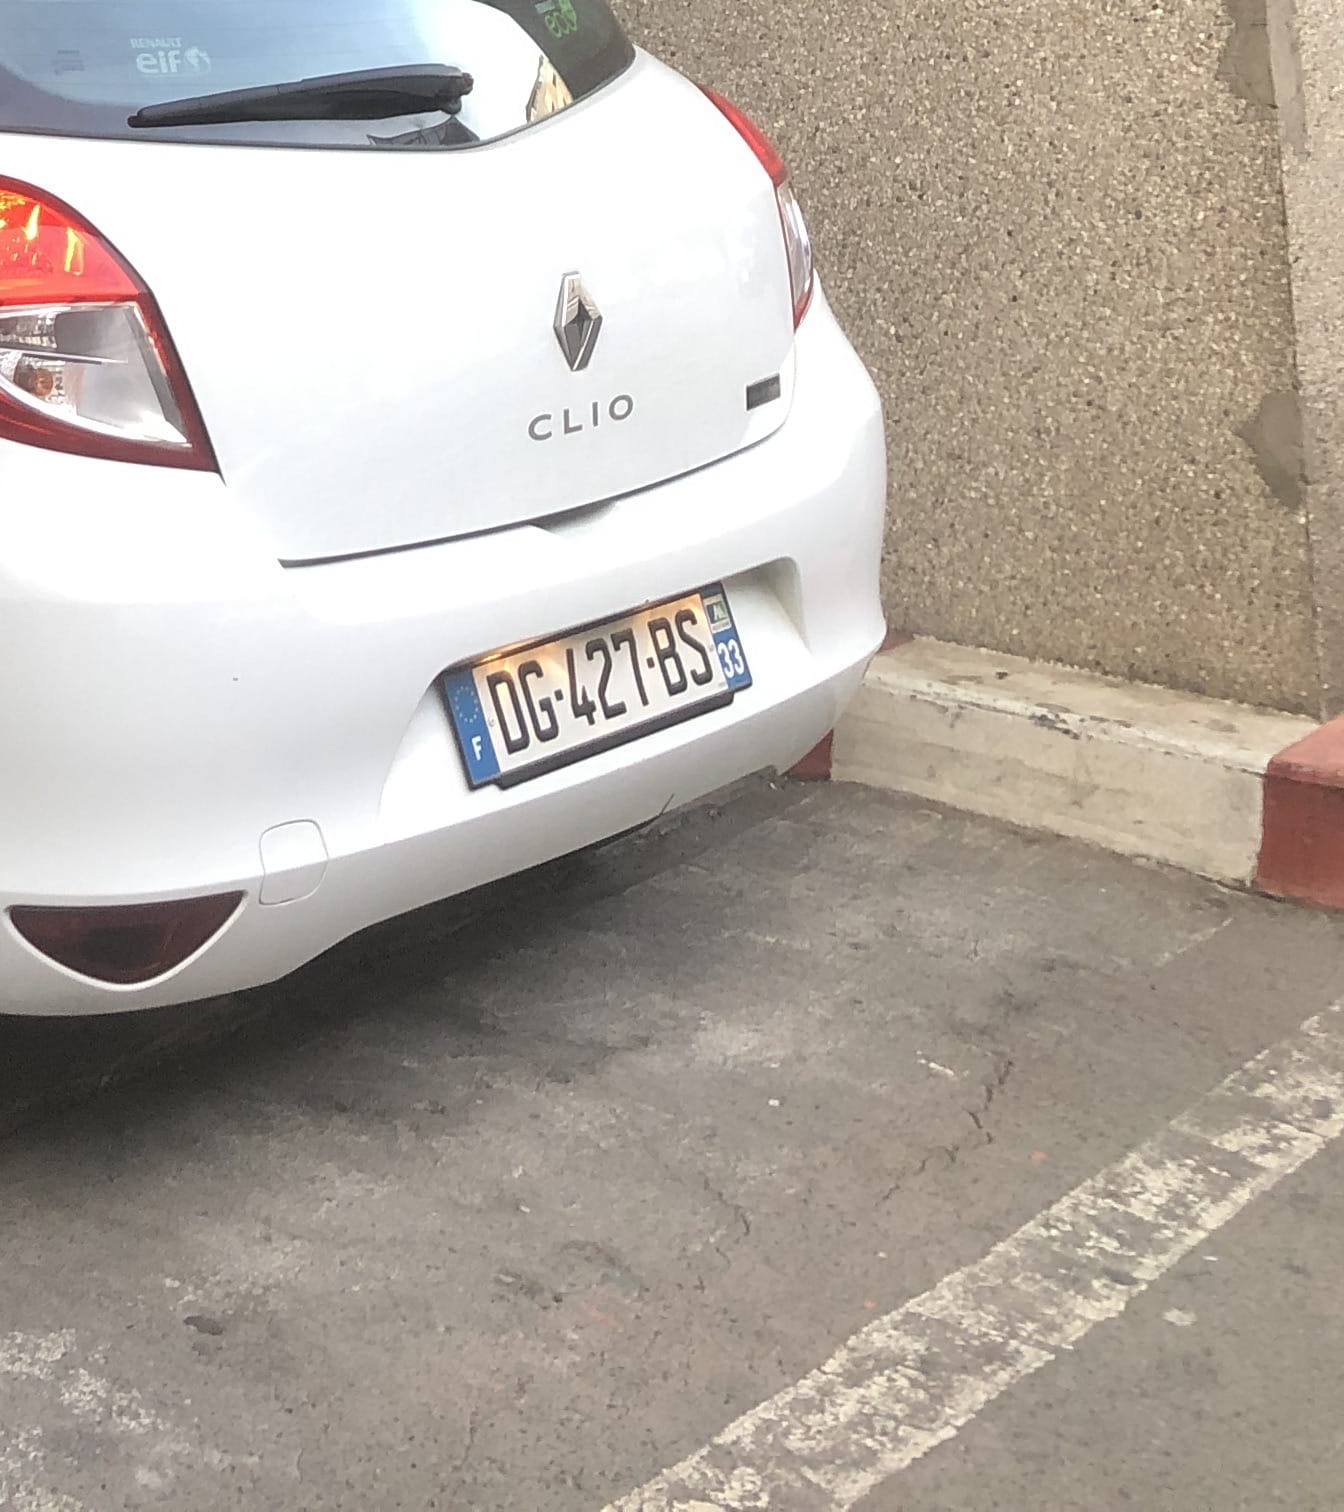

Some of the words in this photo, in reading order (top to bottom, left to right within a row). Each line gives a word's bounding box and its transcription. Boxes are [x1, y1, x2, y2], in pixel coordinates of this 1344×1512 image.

[130, 38, 182, 49] RENAULT
[135, 50, 182, 74] elf
[528, 394, 634, 441] CLIO
[471, 735, 483, 761] F
[717, 639, 745, 679] 33
